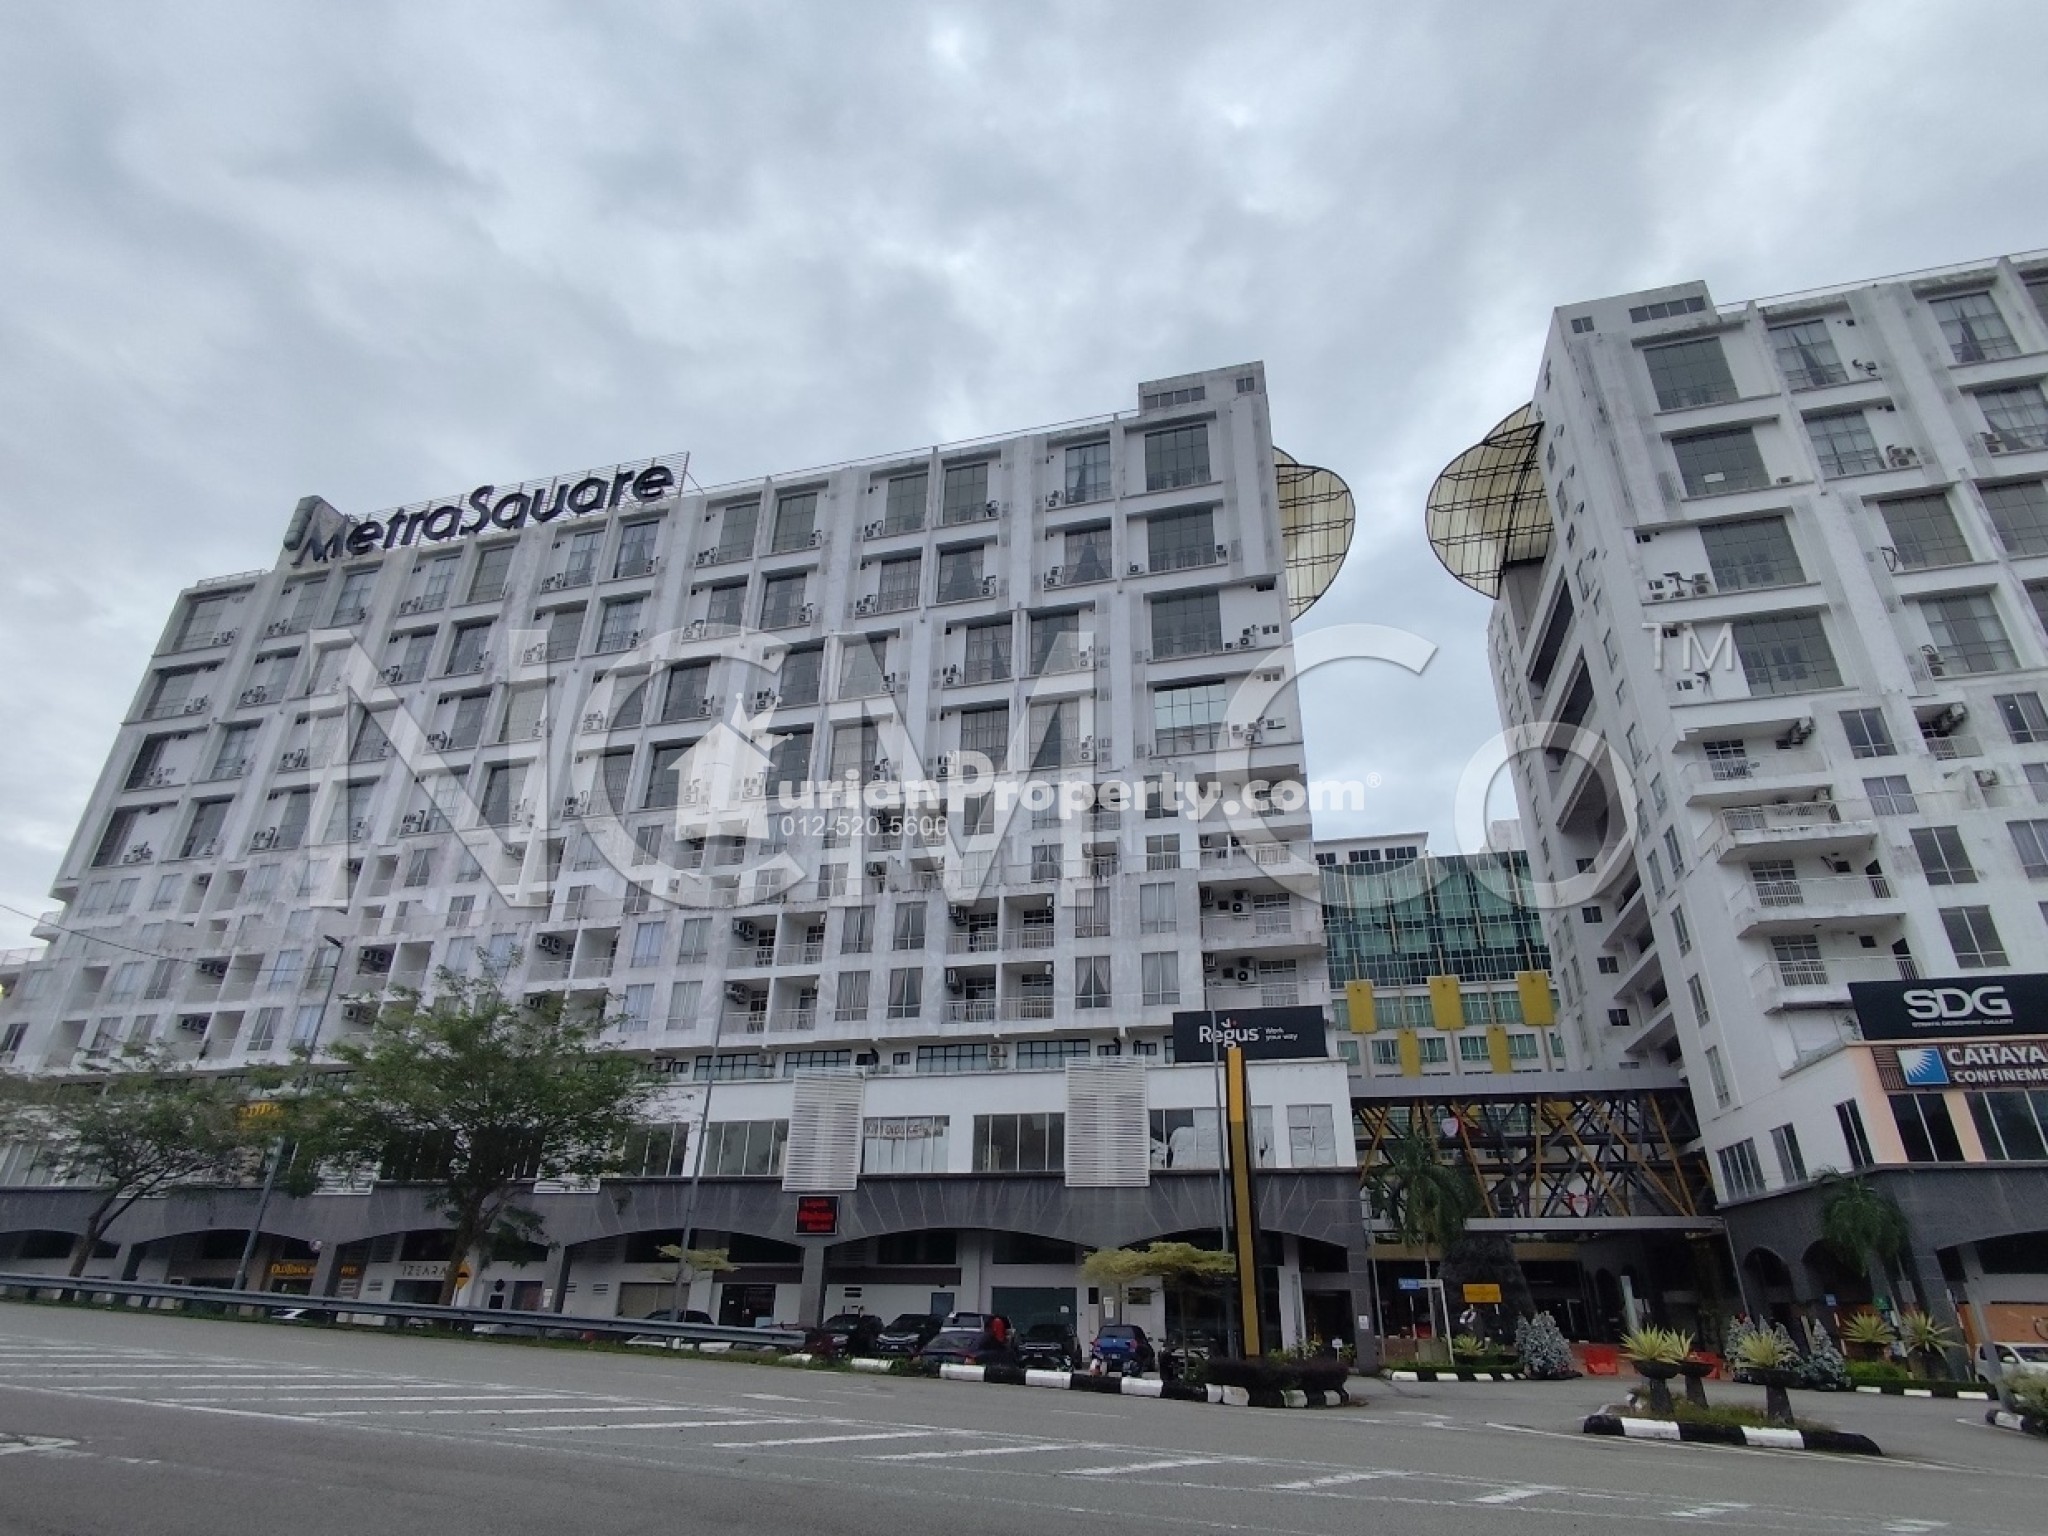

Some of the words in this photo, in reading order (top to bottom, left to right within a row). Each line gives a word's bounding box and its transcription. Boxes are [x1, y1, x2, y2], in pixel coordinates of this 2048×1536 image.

[289, 465, 674, 566] MetraSquare
[1904, 986, 2012, 1019] SDG
[1199, 1025, 1260, 1048] Regus
[1947, 1047, 2048, 1066] CAHAYA
